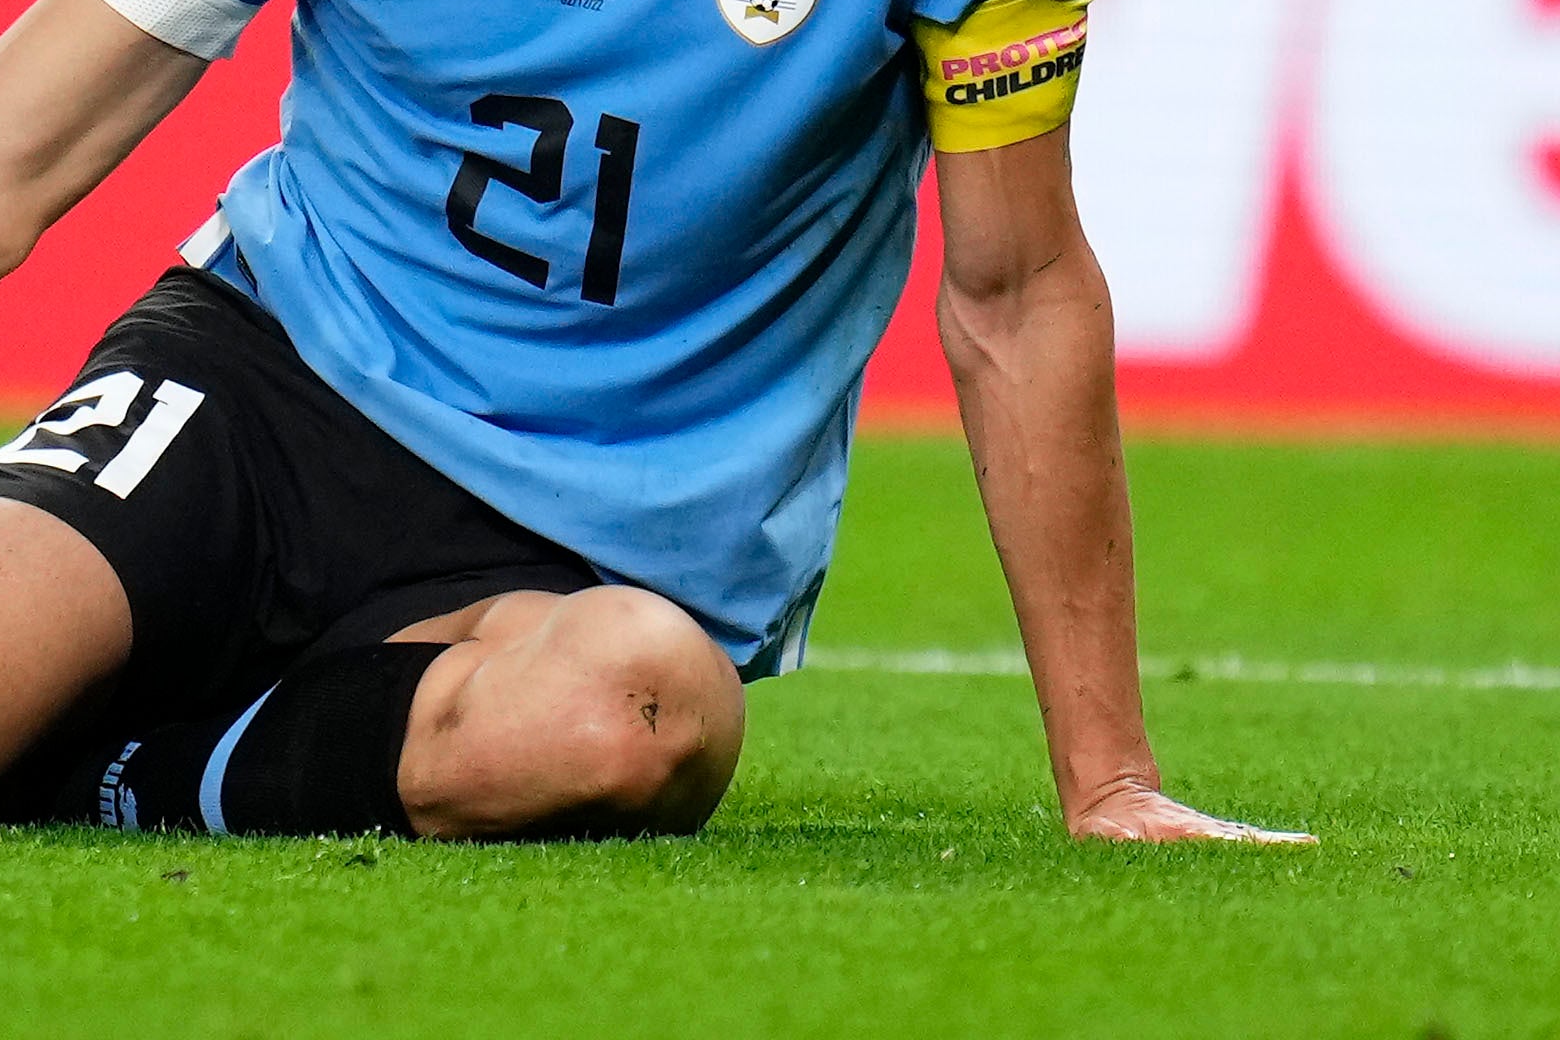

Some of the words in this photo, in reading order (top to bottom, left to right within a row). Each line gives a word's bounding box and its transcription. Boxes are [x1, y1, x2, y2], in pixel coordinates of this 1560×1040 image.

[941, 14, 1088, 81] PROTEC
[945, 42, 1086, 105] CHILDRE
[445, 92, 641, 307] 21
[99, 740, 142, 826] PUM
